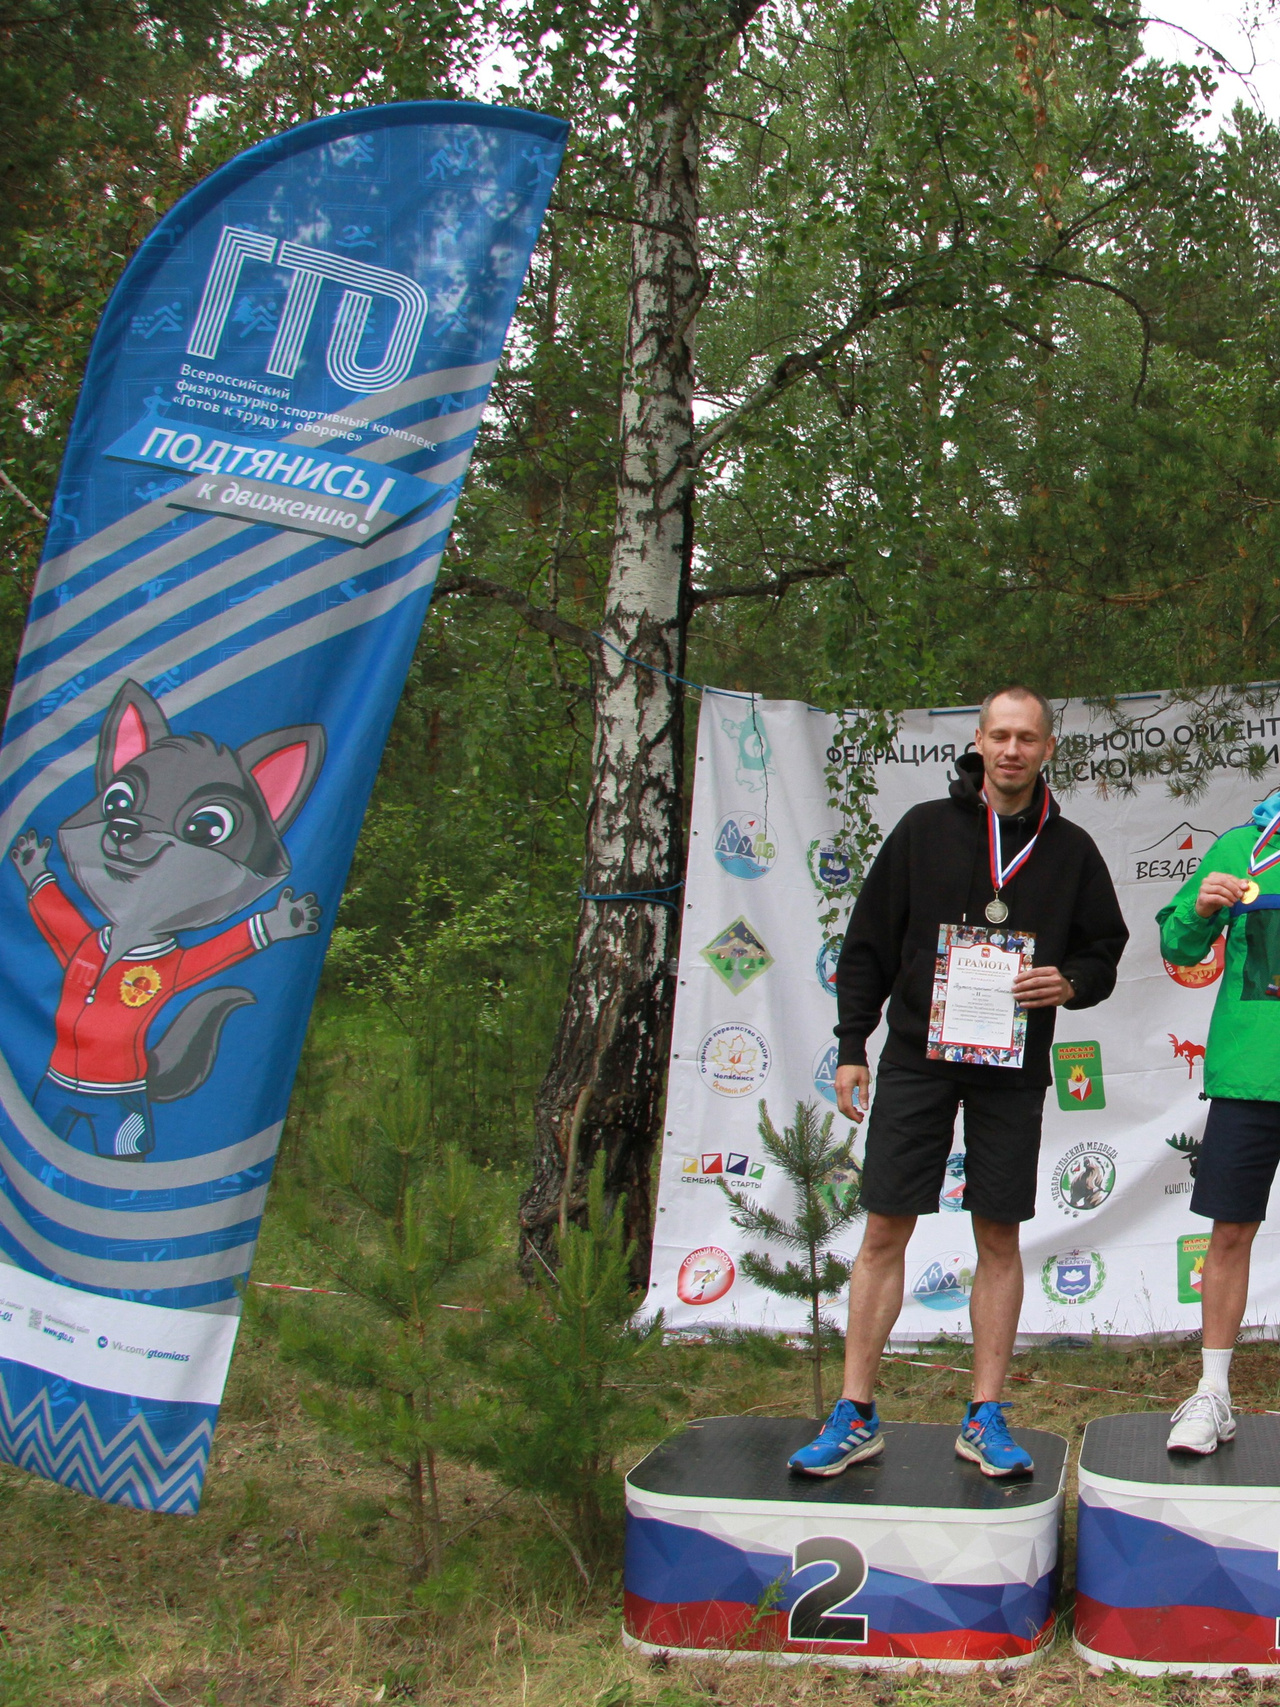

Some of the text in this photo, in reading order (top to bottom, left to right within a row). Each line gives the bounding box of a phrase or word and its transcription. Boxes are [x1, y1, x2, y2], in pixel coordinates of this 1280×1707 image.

[187, 225, 429, 393] ГТО
[180, 363, 291, 401] Всероссийский
[173, 395, 363, 443] «Готов к труду и обороне»
[176, 379, 438, 452] физкультурно-спортивный комплекс
[957, 957, 1011, 971] ГРАМОТА
[713, 1026, 756, 1037] первенство
[756, 1036, 768, 1059] СШОР
[713, 1072, 755, 1081] Челябинск
[730, 1180, 762, 1188] СТАРТЫ
[1051, 1141, 1119, 1202] ЧЕБАРКУЛЬСКИЙ МЕДВЕДЬ
[683, 1247, 732, 1271] ГОРНЫЙ КОРОЛЬ
[112, 1340, 190, 1362] Vk.com/gtomiass
[787, 1535, 868, 1644] 2
